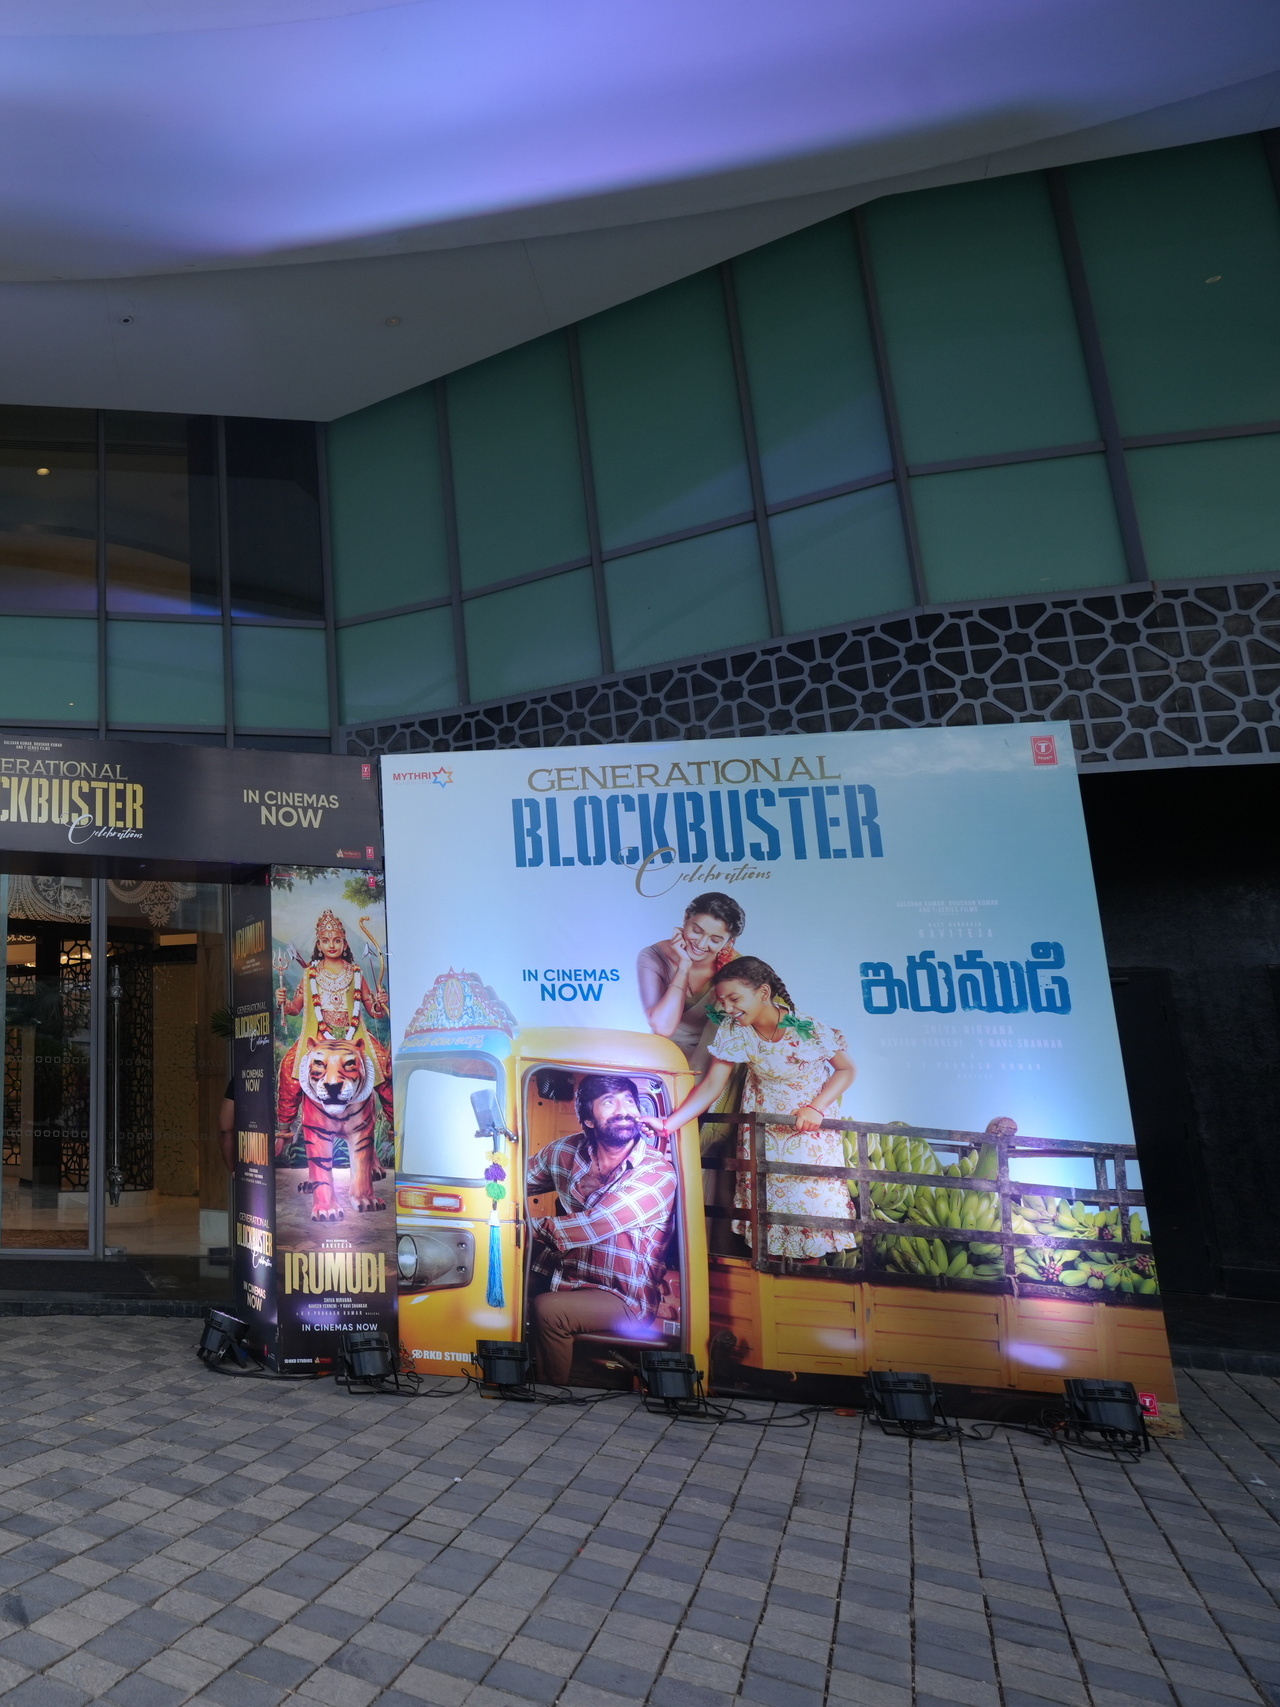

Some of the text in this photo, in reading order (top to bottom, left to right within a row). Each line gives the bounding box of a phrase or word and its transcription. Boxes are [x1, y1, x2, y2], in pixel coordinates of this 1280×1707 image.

[393, 772, 431, 780] MYTHRI
[527, 755, 841, 792] GENERATIONAL
[243, 789, 339, 808] IN CINEMAS
[261, 805, 323, 829] NOW
[60, 813, 143, 845] Celebrations
[511, 784, 884, 868] BLOCKBUSTER
[618, 846, 771, 897] Celebrations
[918, 928, 993, 938] RAVITEJA
[522, 968, 620, 982] IN CINEMAS
[540, 983, 603, 1001] NOW
[924, 1024, 1014, 1035] SHIVA NIRVANA
[242, 1068, 264, 1078] IN CINEMAS
[245, 1078, 260, 1092] NOW
[239, 1212, 269, 1229] GENERATIONAL
[284, 1252, 386, 1295] IRUMUDI
[248, 1283, 266, 1300] CINEMAS
[247, 1294, 263, 1312] NOW
[302, 1323, 378, 1332] IN CINEMAS NOW
[423, 1350, 442, 1360] RKD
